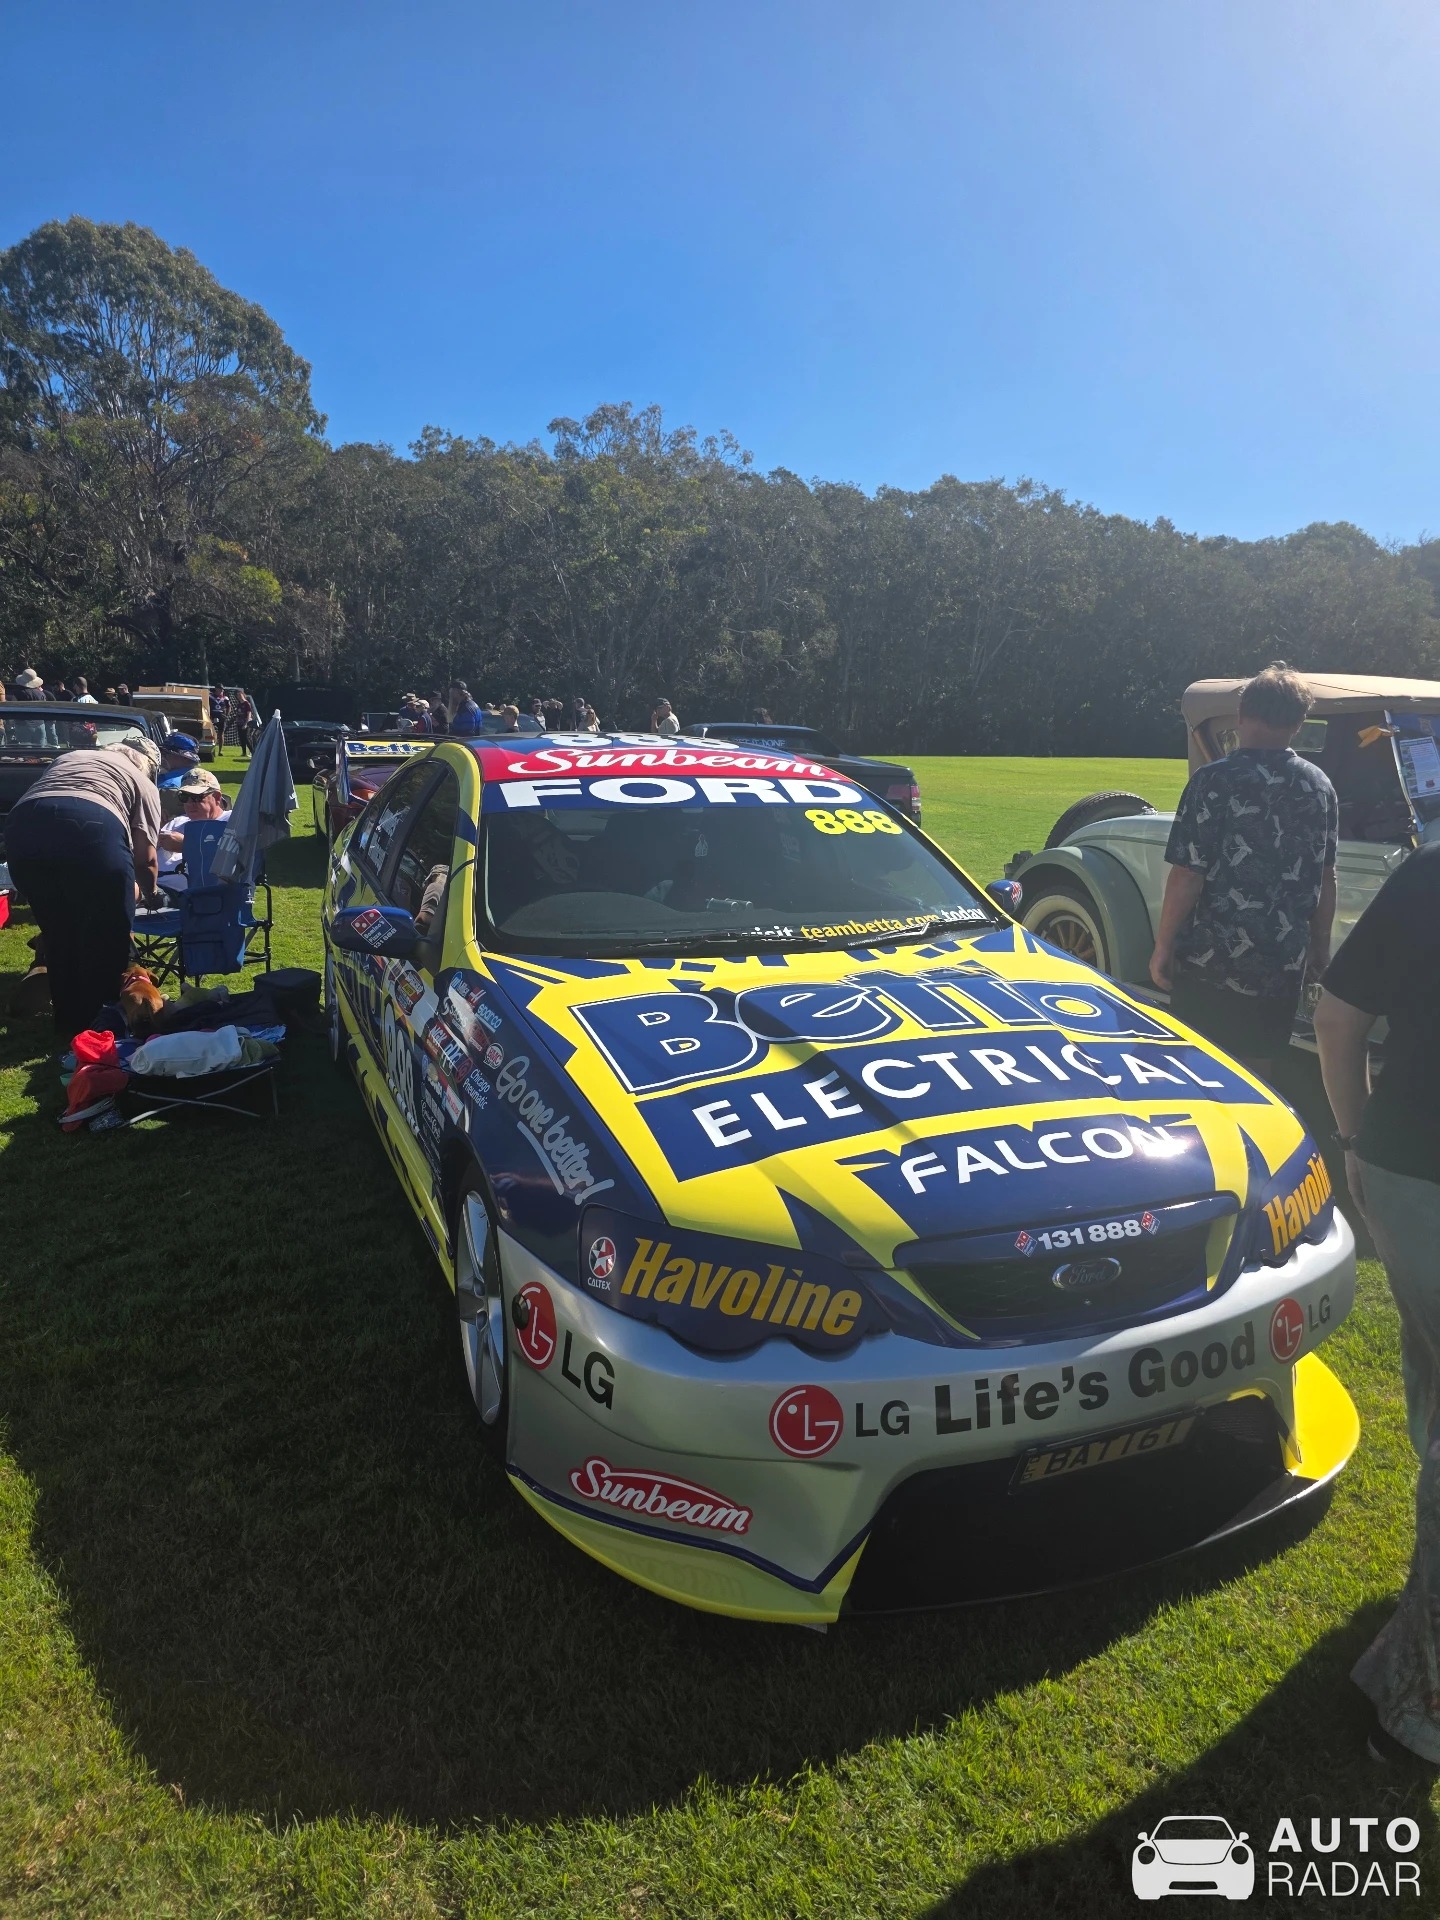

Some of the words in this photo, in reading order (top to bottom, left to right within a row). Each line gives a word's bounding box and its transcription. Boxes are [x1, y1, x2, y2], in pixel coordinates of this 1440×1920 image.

[541, 733, 740, 750] 888
[508, 748, 825, 777] Sunbeam
[500, 777, 862, 808] FORD
[804, 809, 903, 835] 888
[800, 913, 940, 940] teambetta.com
[940, 906, 987, 922] today
[477, 1003, 503, 1029] sparco
[569, 966, 1180, 1094] Betta
[462, 1078, 488, 1110] Pneumatic
[470, 1068, 491, 1093] Chicago
[698, 1041, 1224, 1149] ELECTRICAL
[496, 1055, 530, 1103] Go
[518, 1089, 554, 1133] one
[543, 1115, 615, 1206] better!
[899, 1124, 1187, 1195] FALCON
[1037, 1228, 1084, 1250] 131
[1087, 1219, 1142, 1243] 888
[587, 1276, 611, 1292] CALTEX
[620, 1237, 863, 1336] Havoline
[1068, 1262, 1106, 1285] Ford
[1307, 1293, 1331, 1333] LG
[561, 1329, 615, 1410] LG
[854, 1400, 910, 1438] LG
[934, 1365, 1109, 1436] Life's
[1128, 1320, 1256, 1398] Good
[570, 1459, 750, 1532] Sunbeam
